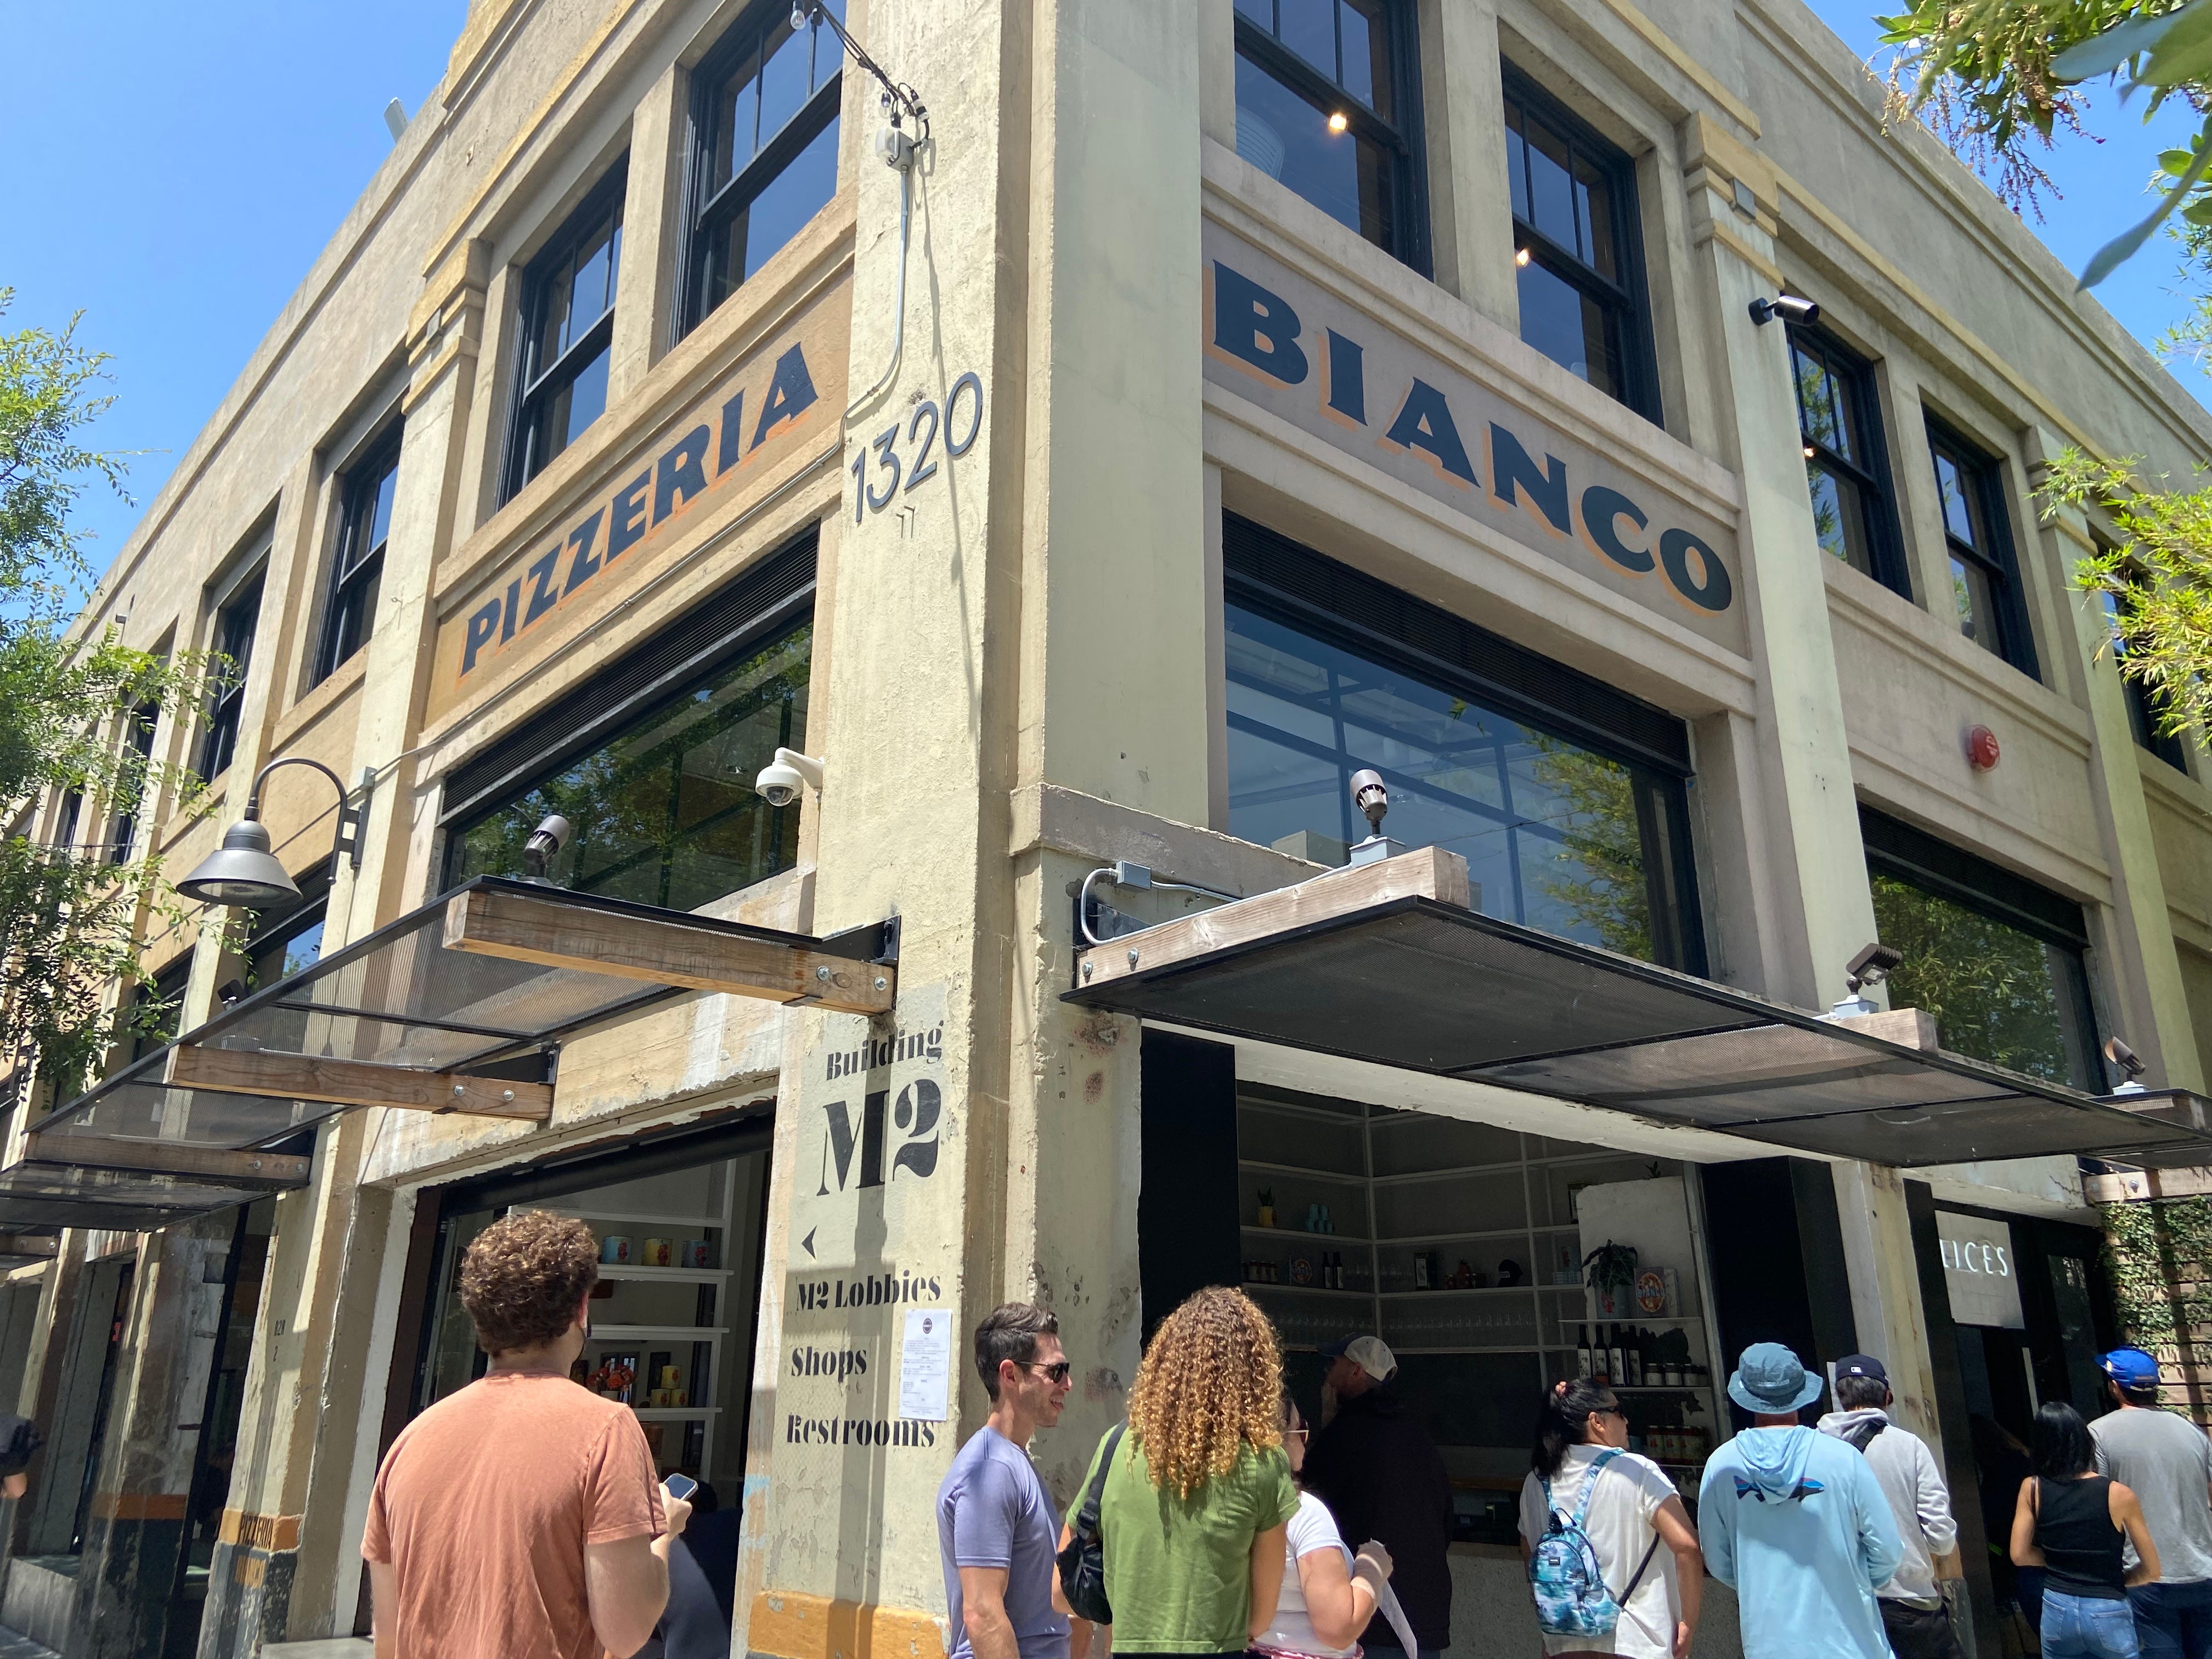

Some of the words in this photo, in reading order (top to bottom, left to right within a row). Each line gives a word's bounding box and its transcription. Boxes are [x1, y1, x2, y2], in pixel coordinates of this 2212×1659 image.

[851, 371, 983, 522] 1320
[1213, 259, 1733, 612] BIANCO
[459, 341, 819, 679] PIZZERIA
[826, 1020, 944, 1081] Building
[816, 1079, 941, 1196] M2
[797, 1280, 829, 1311] M2
[835, 1270, 940, 1307] Lobbies
[792, 1346, 866, 1383] Shops
[787, 1414, 935, 1447] Restrooms
